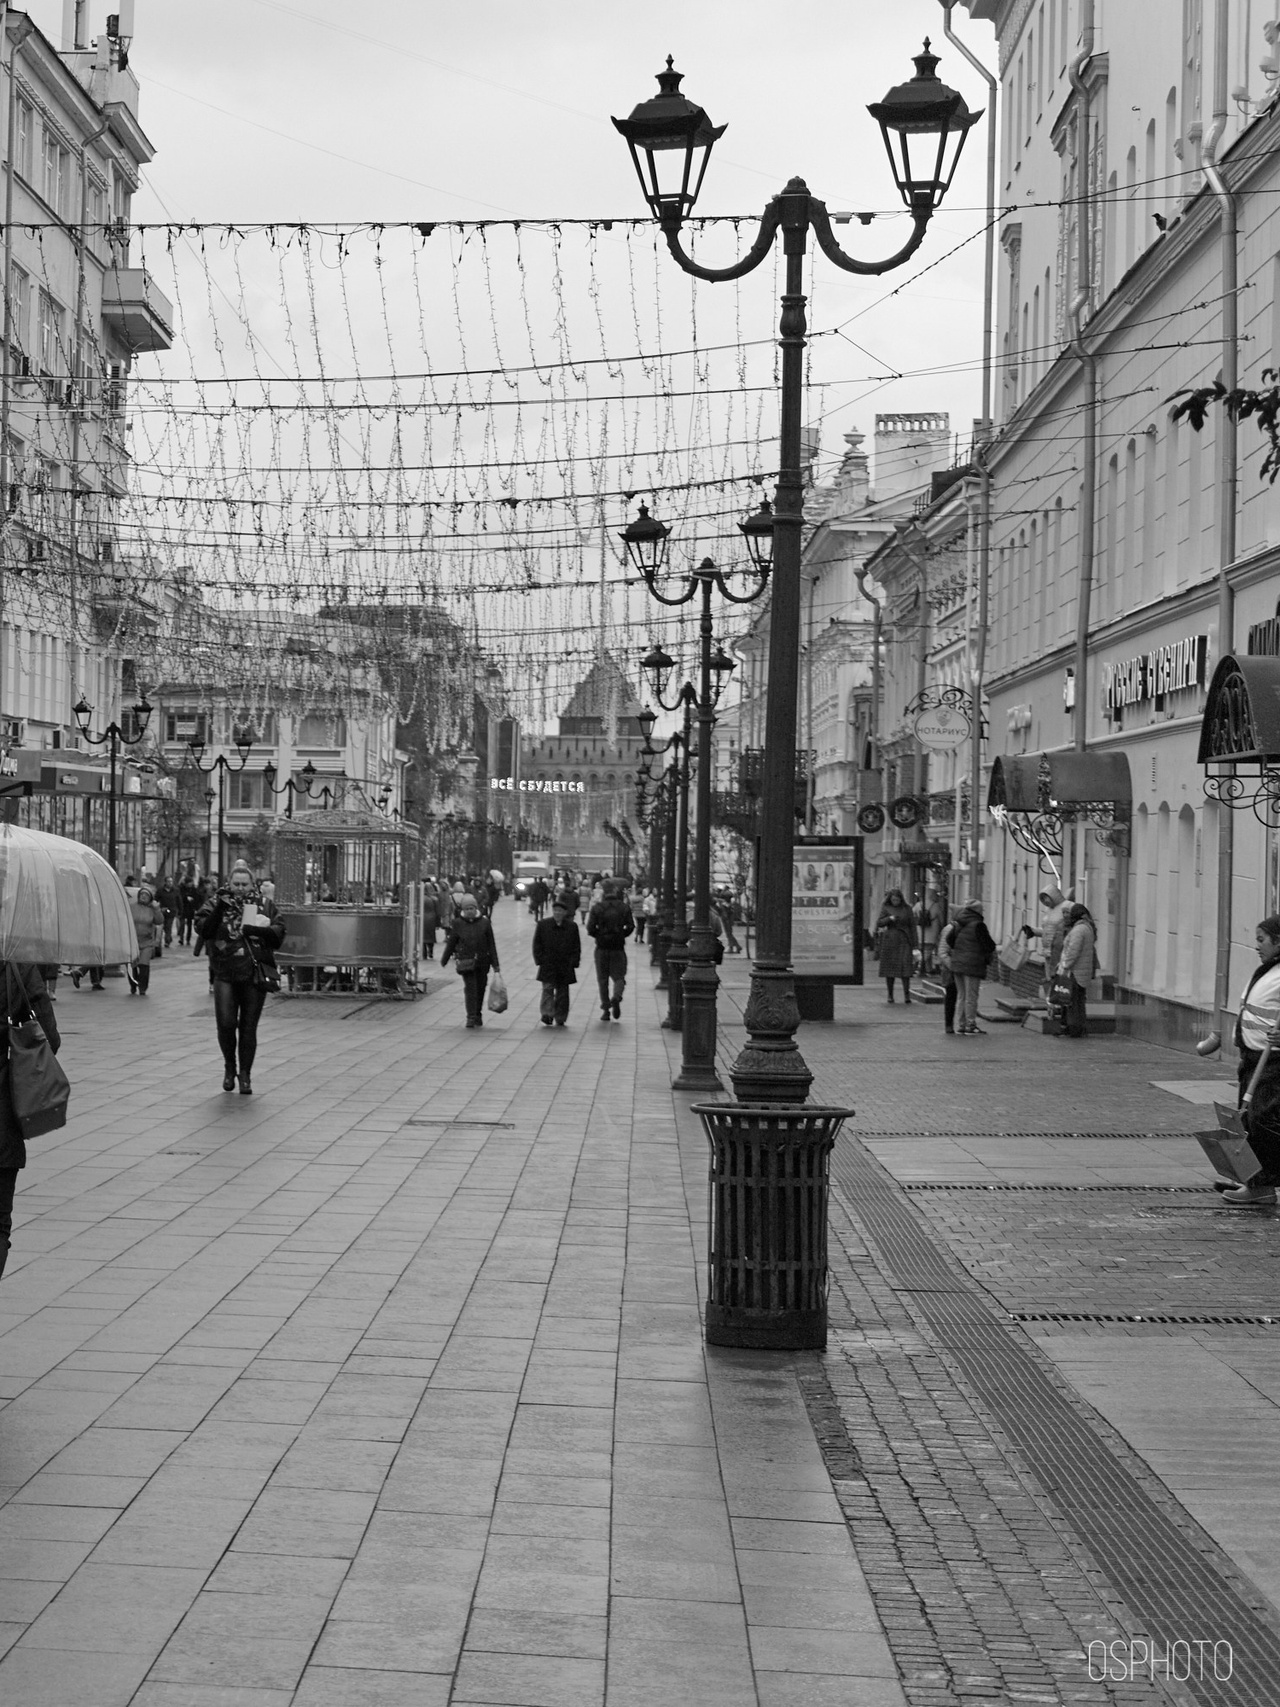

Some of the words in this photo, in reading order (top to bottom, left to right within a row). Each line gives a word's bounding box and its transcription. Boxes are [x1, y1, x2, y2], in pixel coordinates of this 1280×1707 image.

[1106, 655, 1143, 708] РУССКИЕ
[1147, 635, 1200, 698] СУВЕНИРЫ
[918, 727, 967, 736] НОТАРИУС
[491, 777, 514, 790] ВСЁ
[519, 780, 585, 793] СБУДЕТСЯ
